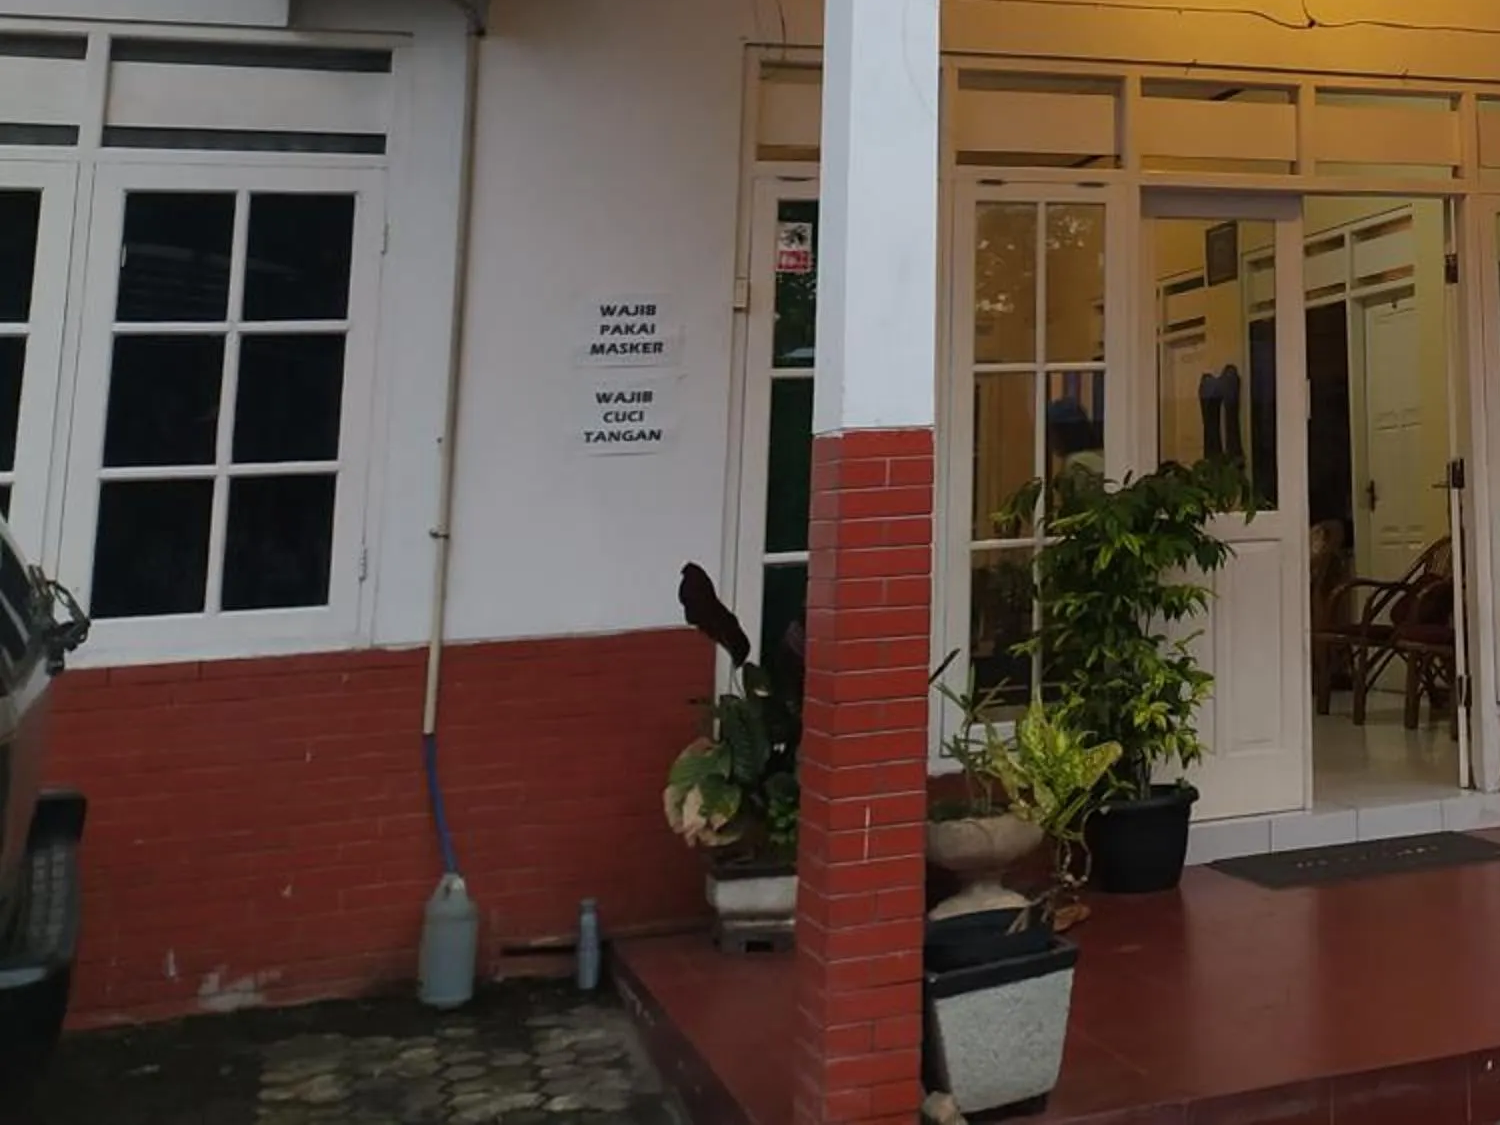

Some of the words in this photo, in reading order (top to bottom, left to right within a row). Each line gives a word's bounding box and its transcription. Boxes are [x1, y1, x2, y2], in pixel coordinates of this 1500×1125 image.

[600, 304, 656, 316] WAJIB
[600, 323, 655, 336] PAKAI
[590, 342, 663, 355] MASKER
[596, 391, 653, 404] WAJIB
[603, 410, 644, 423] CUCI
[584, 429, 662, 443] TANGAN
